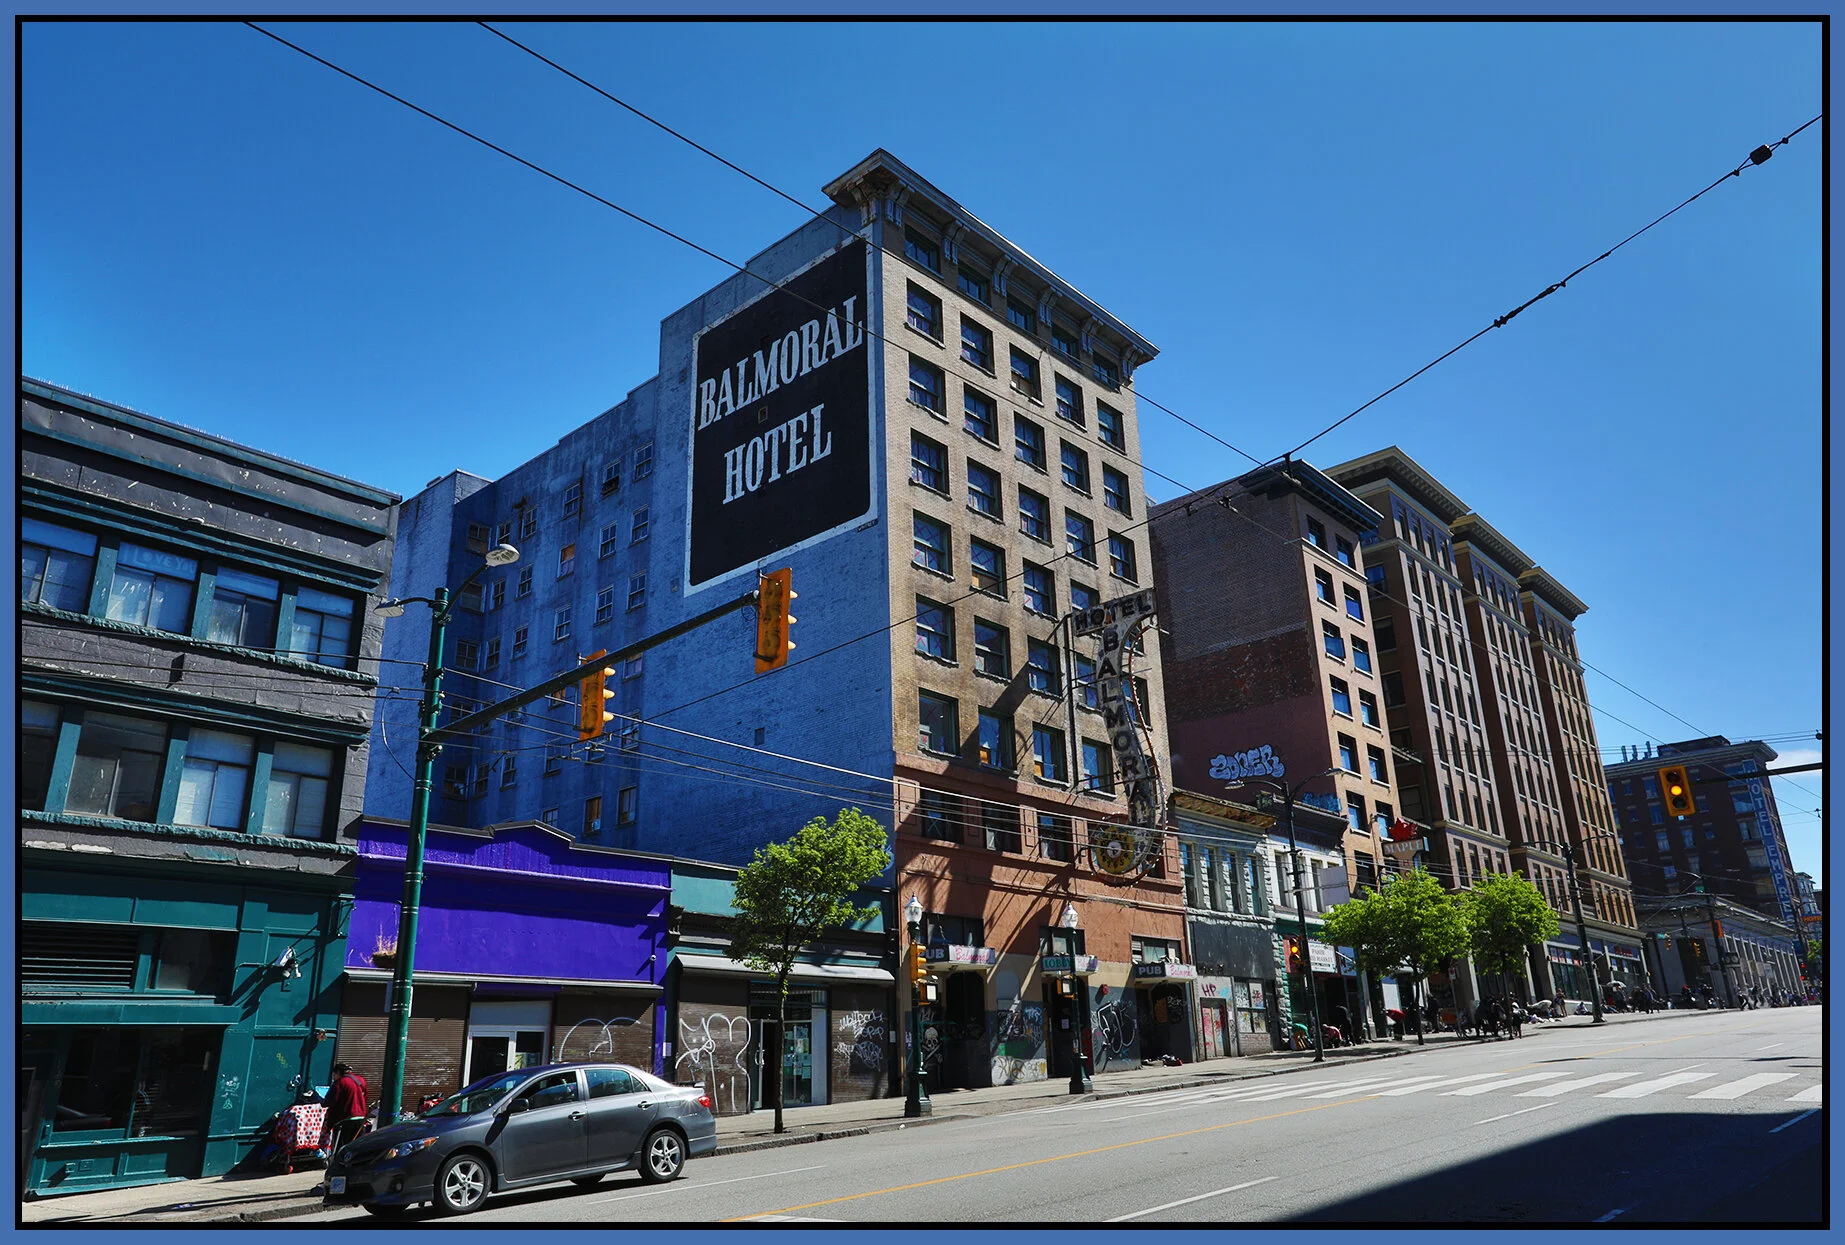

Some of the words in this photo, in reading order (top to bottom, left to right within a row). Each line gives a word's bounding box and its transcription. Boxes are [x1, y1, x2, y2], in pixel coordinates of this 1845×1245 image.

[698, 295, 863, 431] BALMORAL
[722, 403, 832, 505] HOTEL
[1075, 594, 1152, 631] HOTEL
[1384, 839, 1422, 855] MAPLE
[1138, 965, 1162, 976] PUB
[1201, 983, 1217, 997] HP
